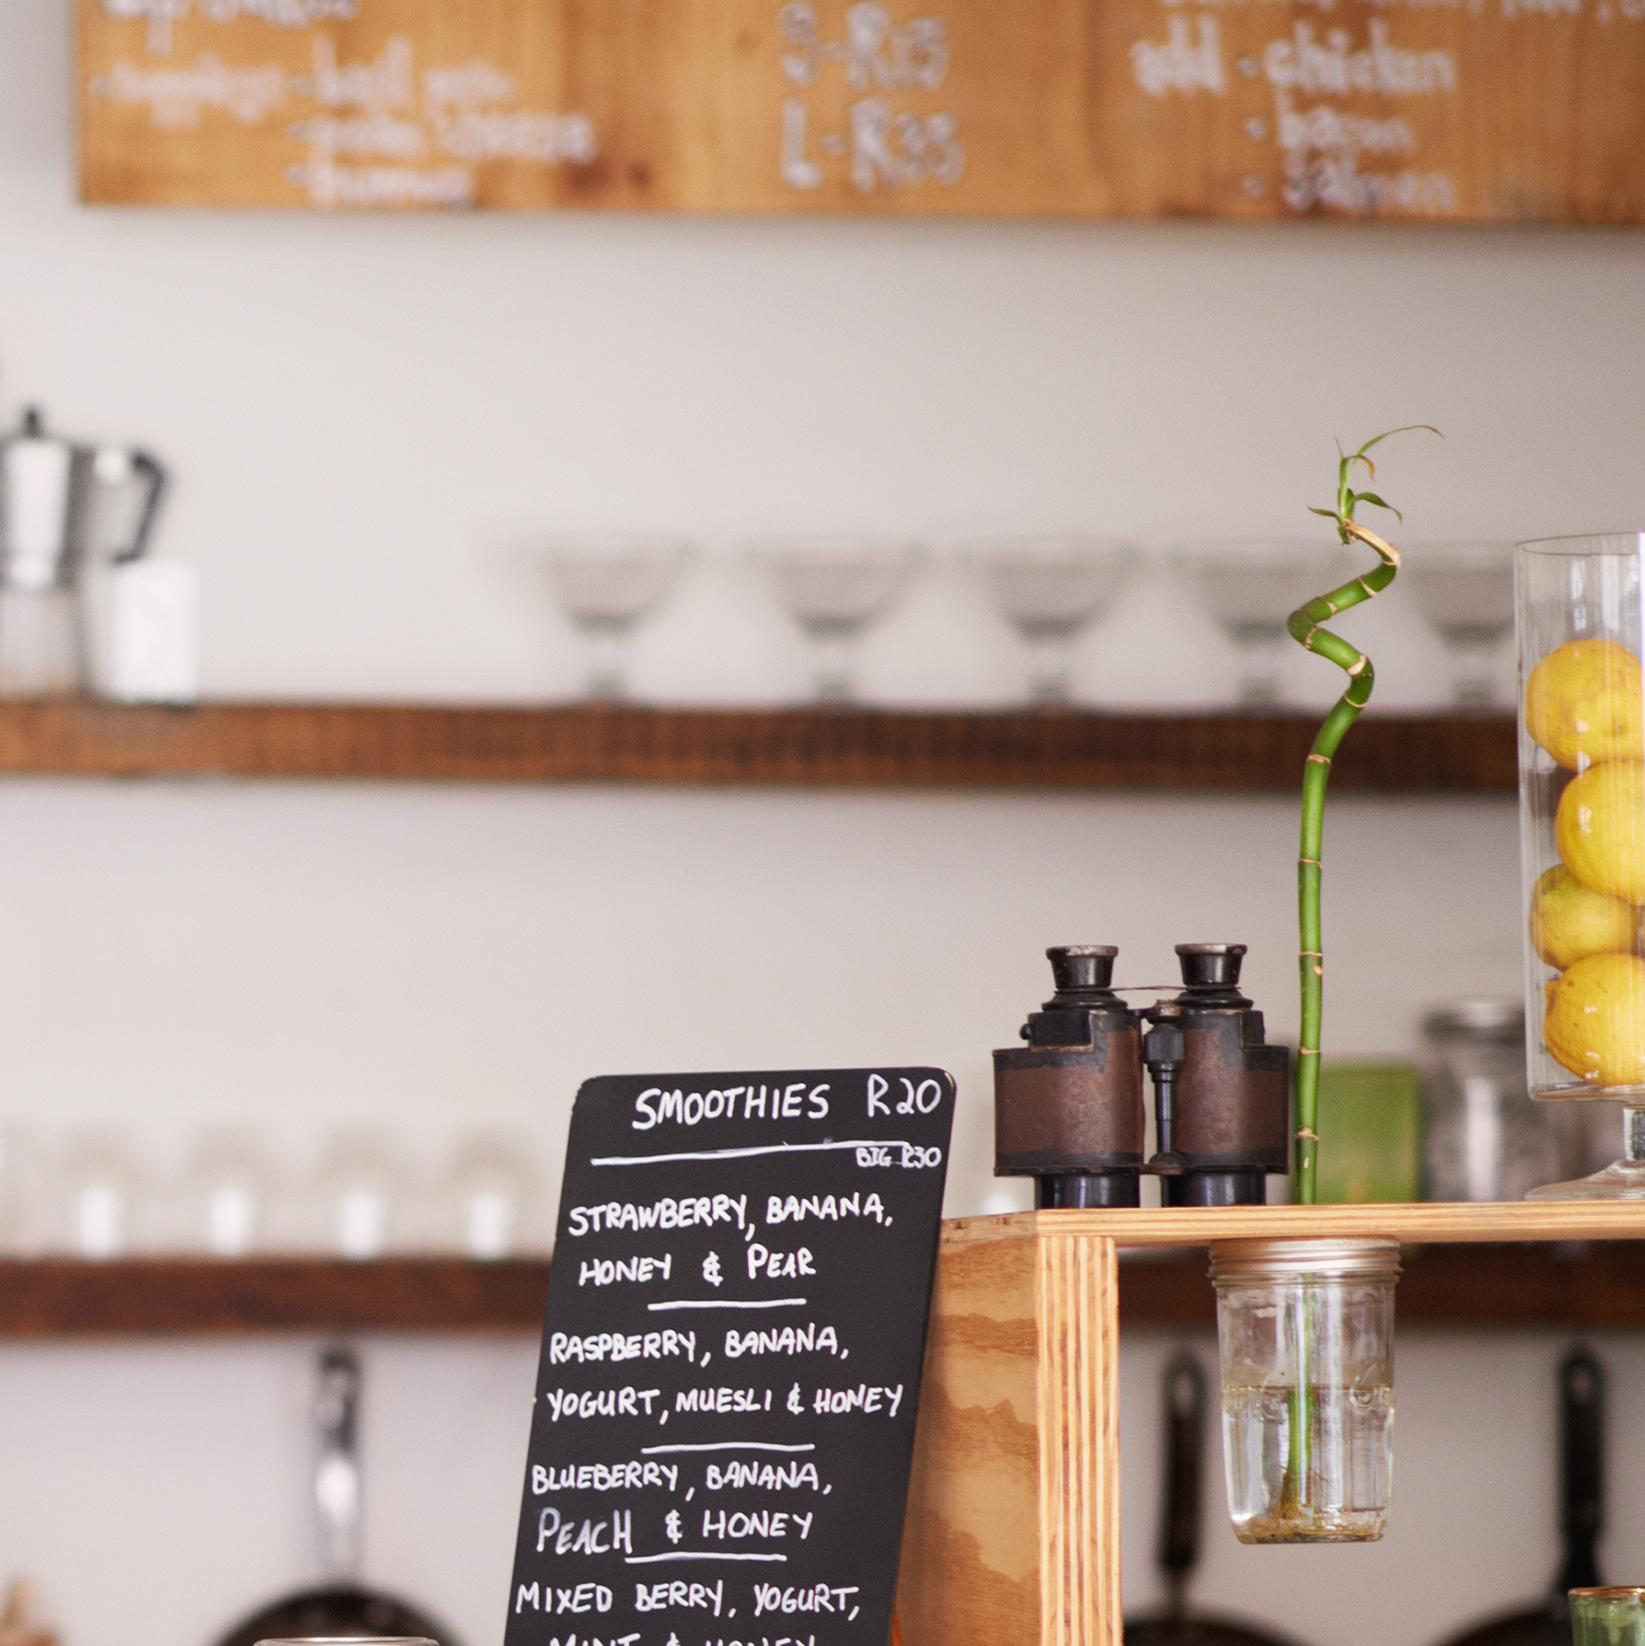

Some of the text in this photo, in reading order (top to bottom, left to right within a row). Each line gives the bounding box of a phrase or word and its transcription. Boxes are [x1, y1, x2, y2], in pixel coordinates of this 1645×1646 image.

[632, 1074, 941, 1129] SMOOTHIES R20
[855, 1147, 892, 1168] BIG
[569, 1192, 892, 1241] STRAWBERRY, BANANA,
[579, 1243, 816, 1286] HONEY & PEAR
[550, 1323, 848, 1367] RASPBERRY, BANANA,
[547, 1383, 903, 1424] YOGURT, MUESLI & HONEY
[533, 1461, 831, 1501] BLUEBERRY, BANANA,
[537, 1508, 812, 1554] PEACH & HONEY
[516, 1580, 859, 1621] MIXED BERRY, YOGURT,
